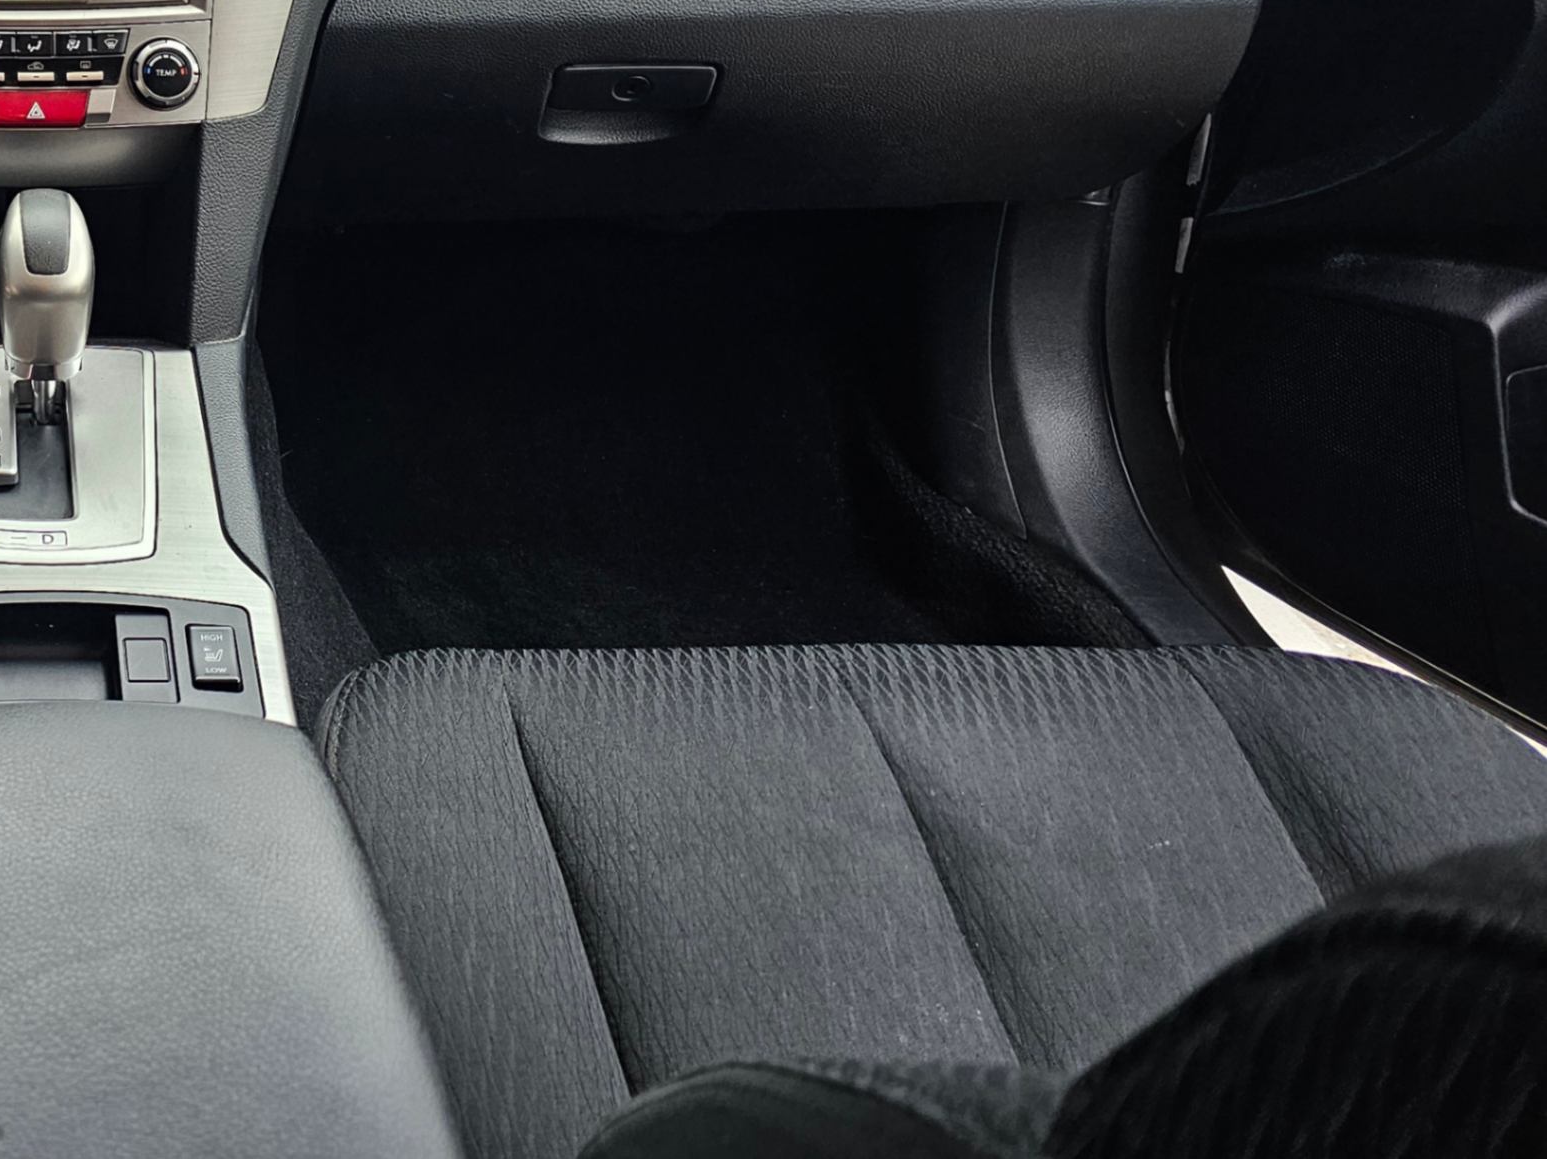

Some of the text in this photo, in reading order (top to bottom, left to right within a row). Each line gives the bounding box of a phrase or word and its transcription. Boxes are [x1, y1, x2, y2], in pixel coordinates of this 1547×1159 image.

[155, 69, 176, 77] TEMP
[42, 535, 54, 544] D
[200, 633, 224, 641] HIGH
